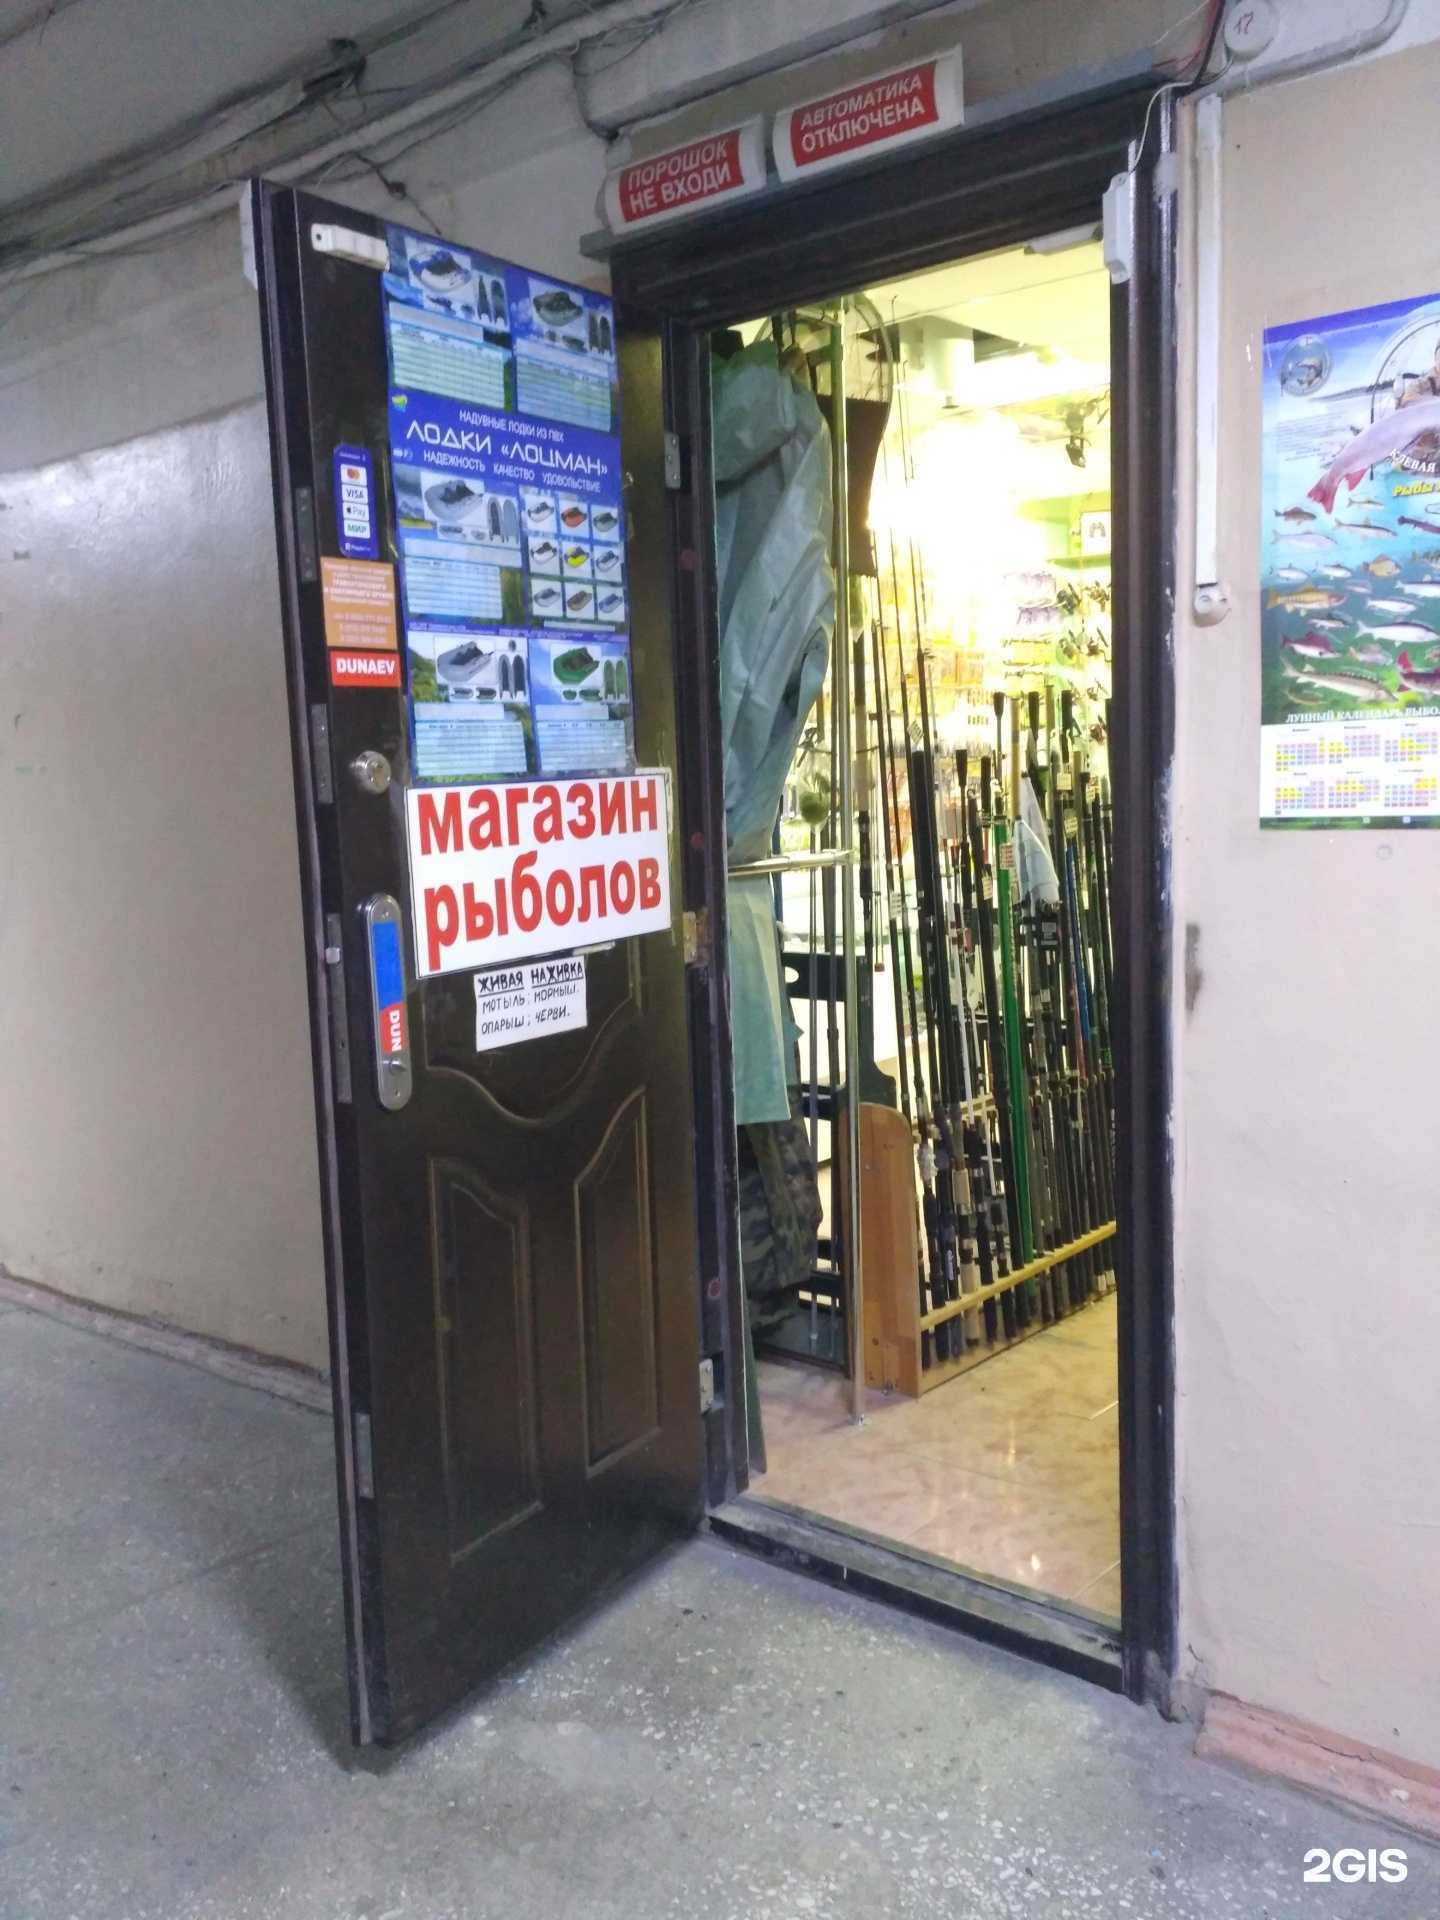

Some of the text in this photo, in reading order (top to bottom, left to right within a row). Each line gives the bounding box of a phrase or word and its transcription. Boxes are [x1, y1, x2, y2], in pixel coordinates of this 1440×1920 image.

[800, 73, 922, 131] АВТОМАТИКА
[802, 99, 925, 152] ОТКЛЮЧЕНА
[627, 138, 728, 190] ПОРОШОК
[631, 162, 731, 214] НЕ ВХОДИ
[406, 420, 608, 476] ЛОДКИ «ЛОЦМАН»
[423, 449, 486, 473] НАДЕЖНОСТЬ
[493, 463, 535, 481] КАЧЕСТВО
[346, 488, 364, 499] VISA
[336, 658, 395, 675] DUNAEV
[1286, 710, 1333, 723] ЛУННЫЙ
[1405, 705, 1440, 718] РЫБО
[417, 779, 658, 856] магазин
[424, 850, 661, 972] рыболов
[478, 962, 583, 993] ЖИВАЯ НАЖИВКА
